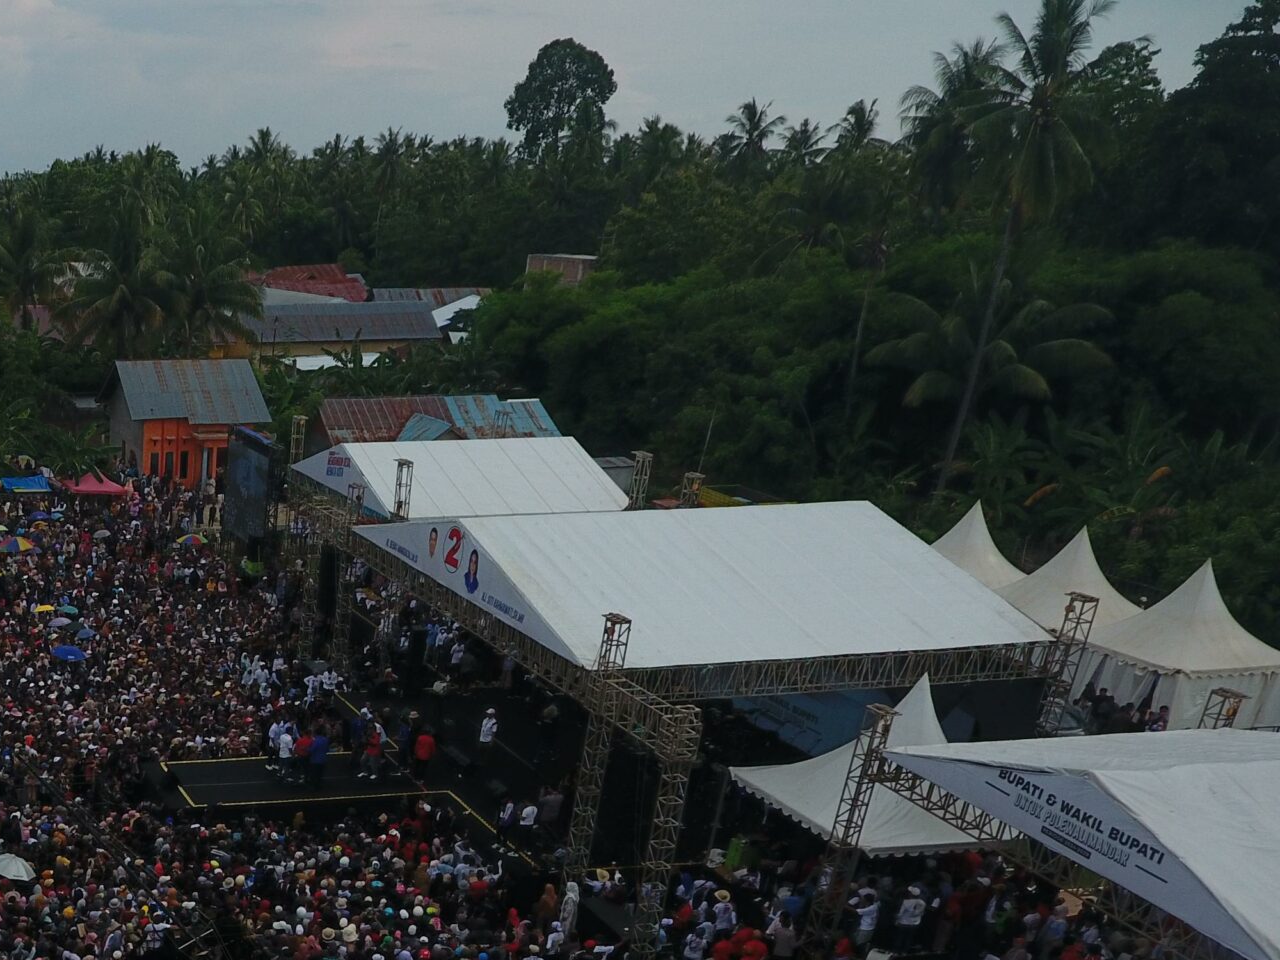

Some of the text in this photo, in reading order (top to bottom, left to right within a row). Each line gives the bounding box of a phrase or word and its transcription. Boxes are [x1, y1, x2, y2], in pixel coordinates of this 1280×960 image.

[444, 527, 463, 570] 2
[998, 769, 1044, 800] BUPATI
[1045, 793, 1057, 806] &
[1060, 799, 1105, 834] WAKIL
[1108, 826, 1165, 865] BUPATI
[1013, 793, 1044, 819] UNTUK
